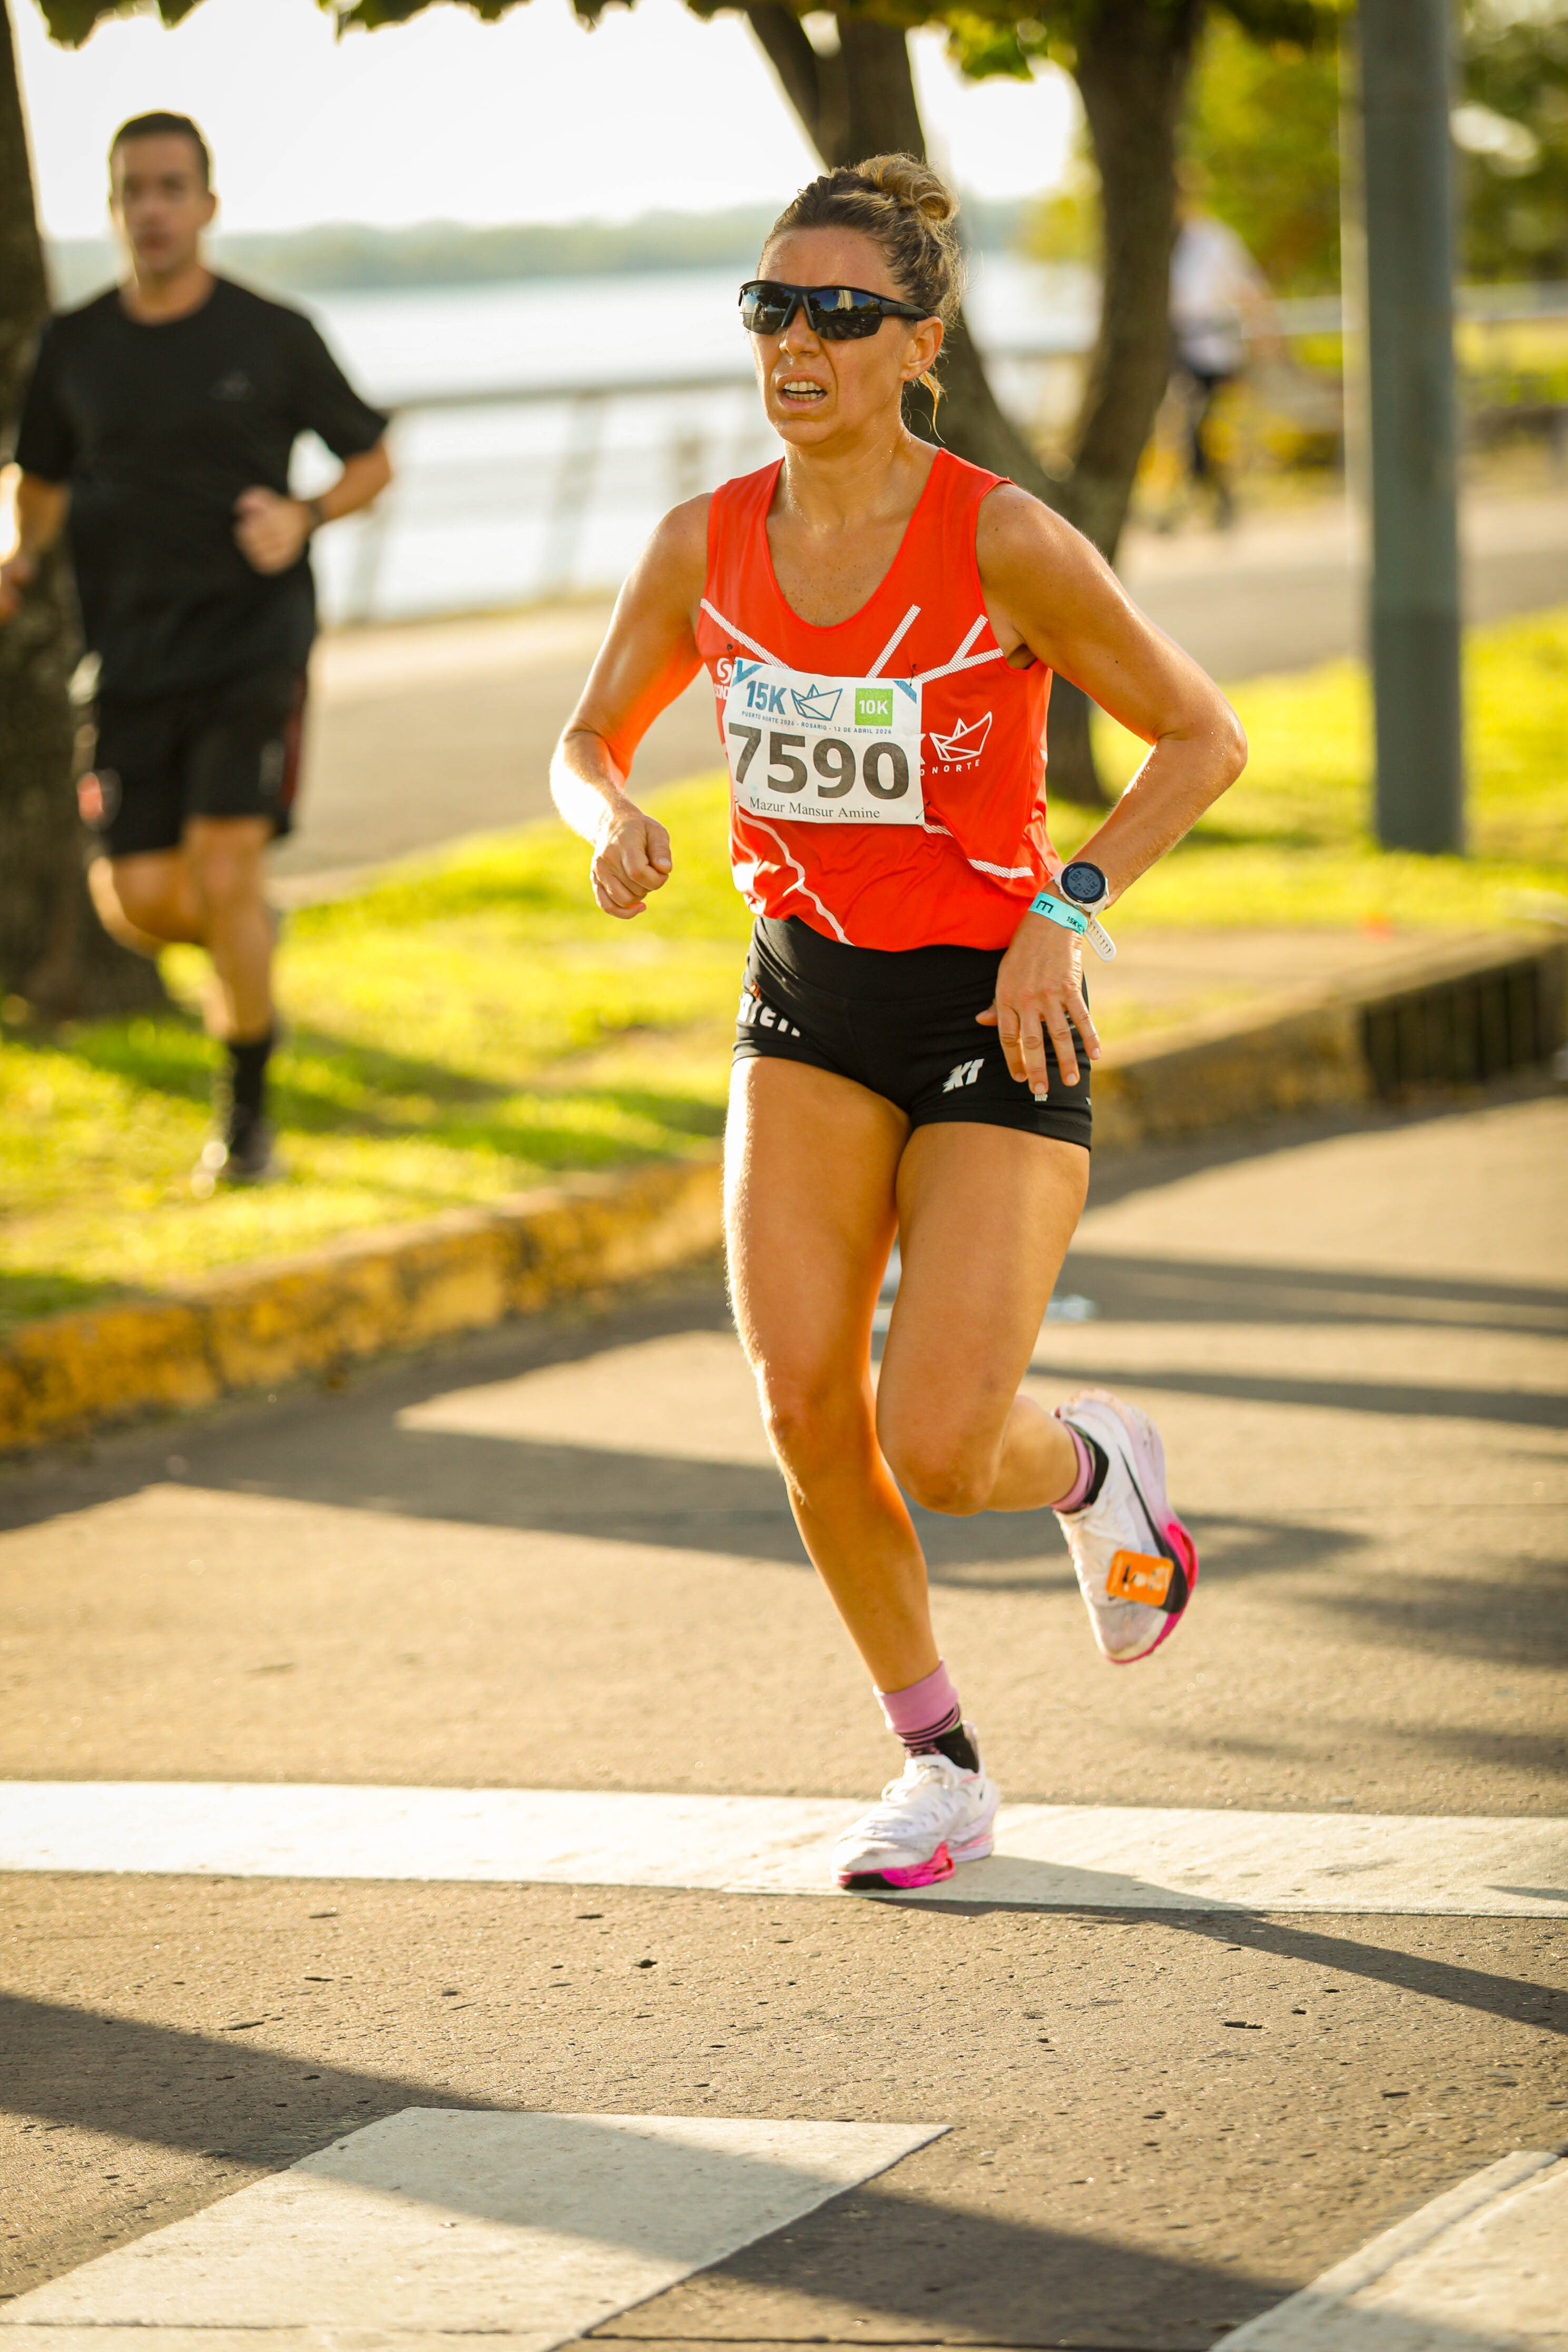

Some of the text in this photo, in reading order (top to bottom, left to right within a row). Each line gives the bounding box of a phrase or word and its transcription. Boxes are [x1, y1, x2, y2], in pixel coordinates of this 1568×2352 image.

[747, 680, 787, 714] 15K
[859, 700, 889, 714] 10K
[742, 710, 761, 720] PUERTO
[762, 714, 779, 723] NORTE
[801, 721, 827, 730] ROSARIO
[729, 722, 909, 800] 7590
[932, 759, 980, 775] NORTE
[749, 796, 880, 818] Mazur Mansur Amine
[1066, 916, 1078, 927] 15K
